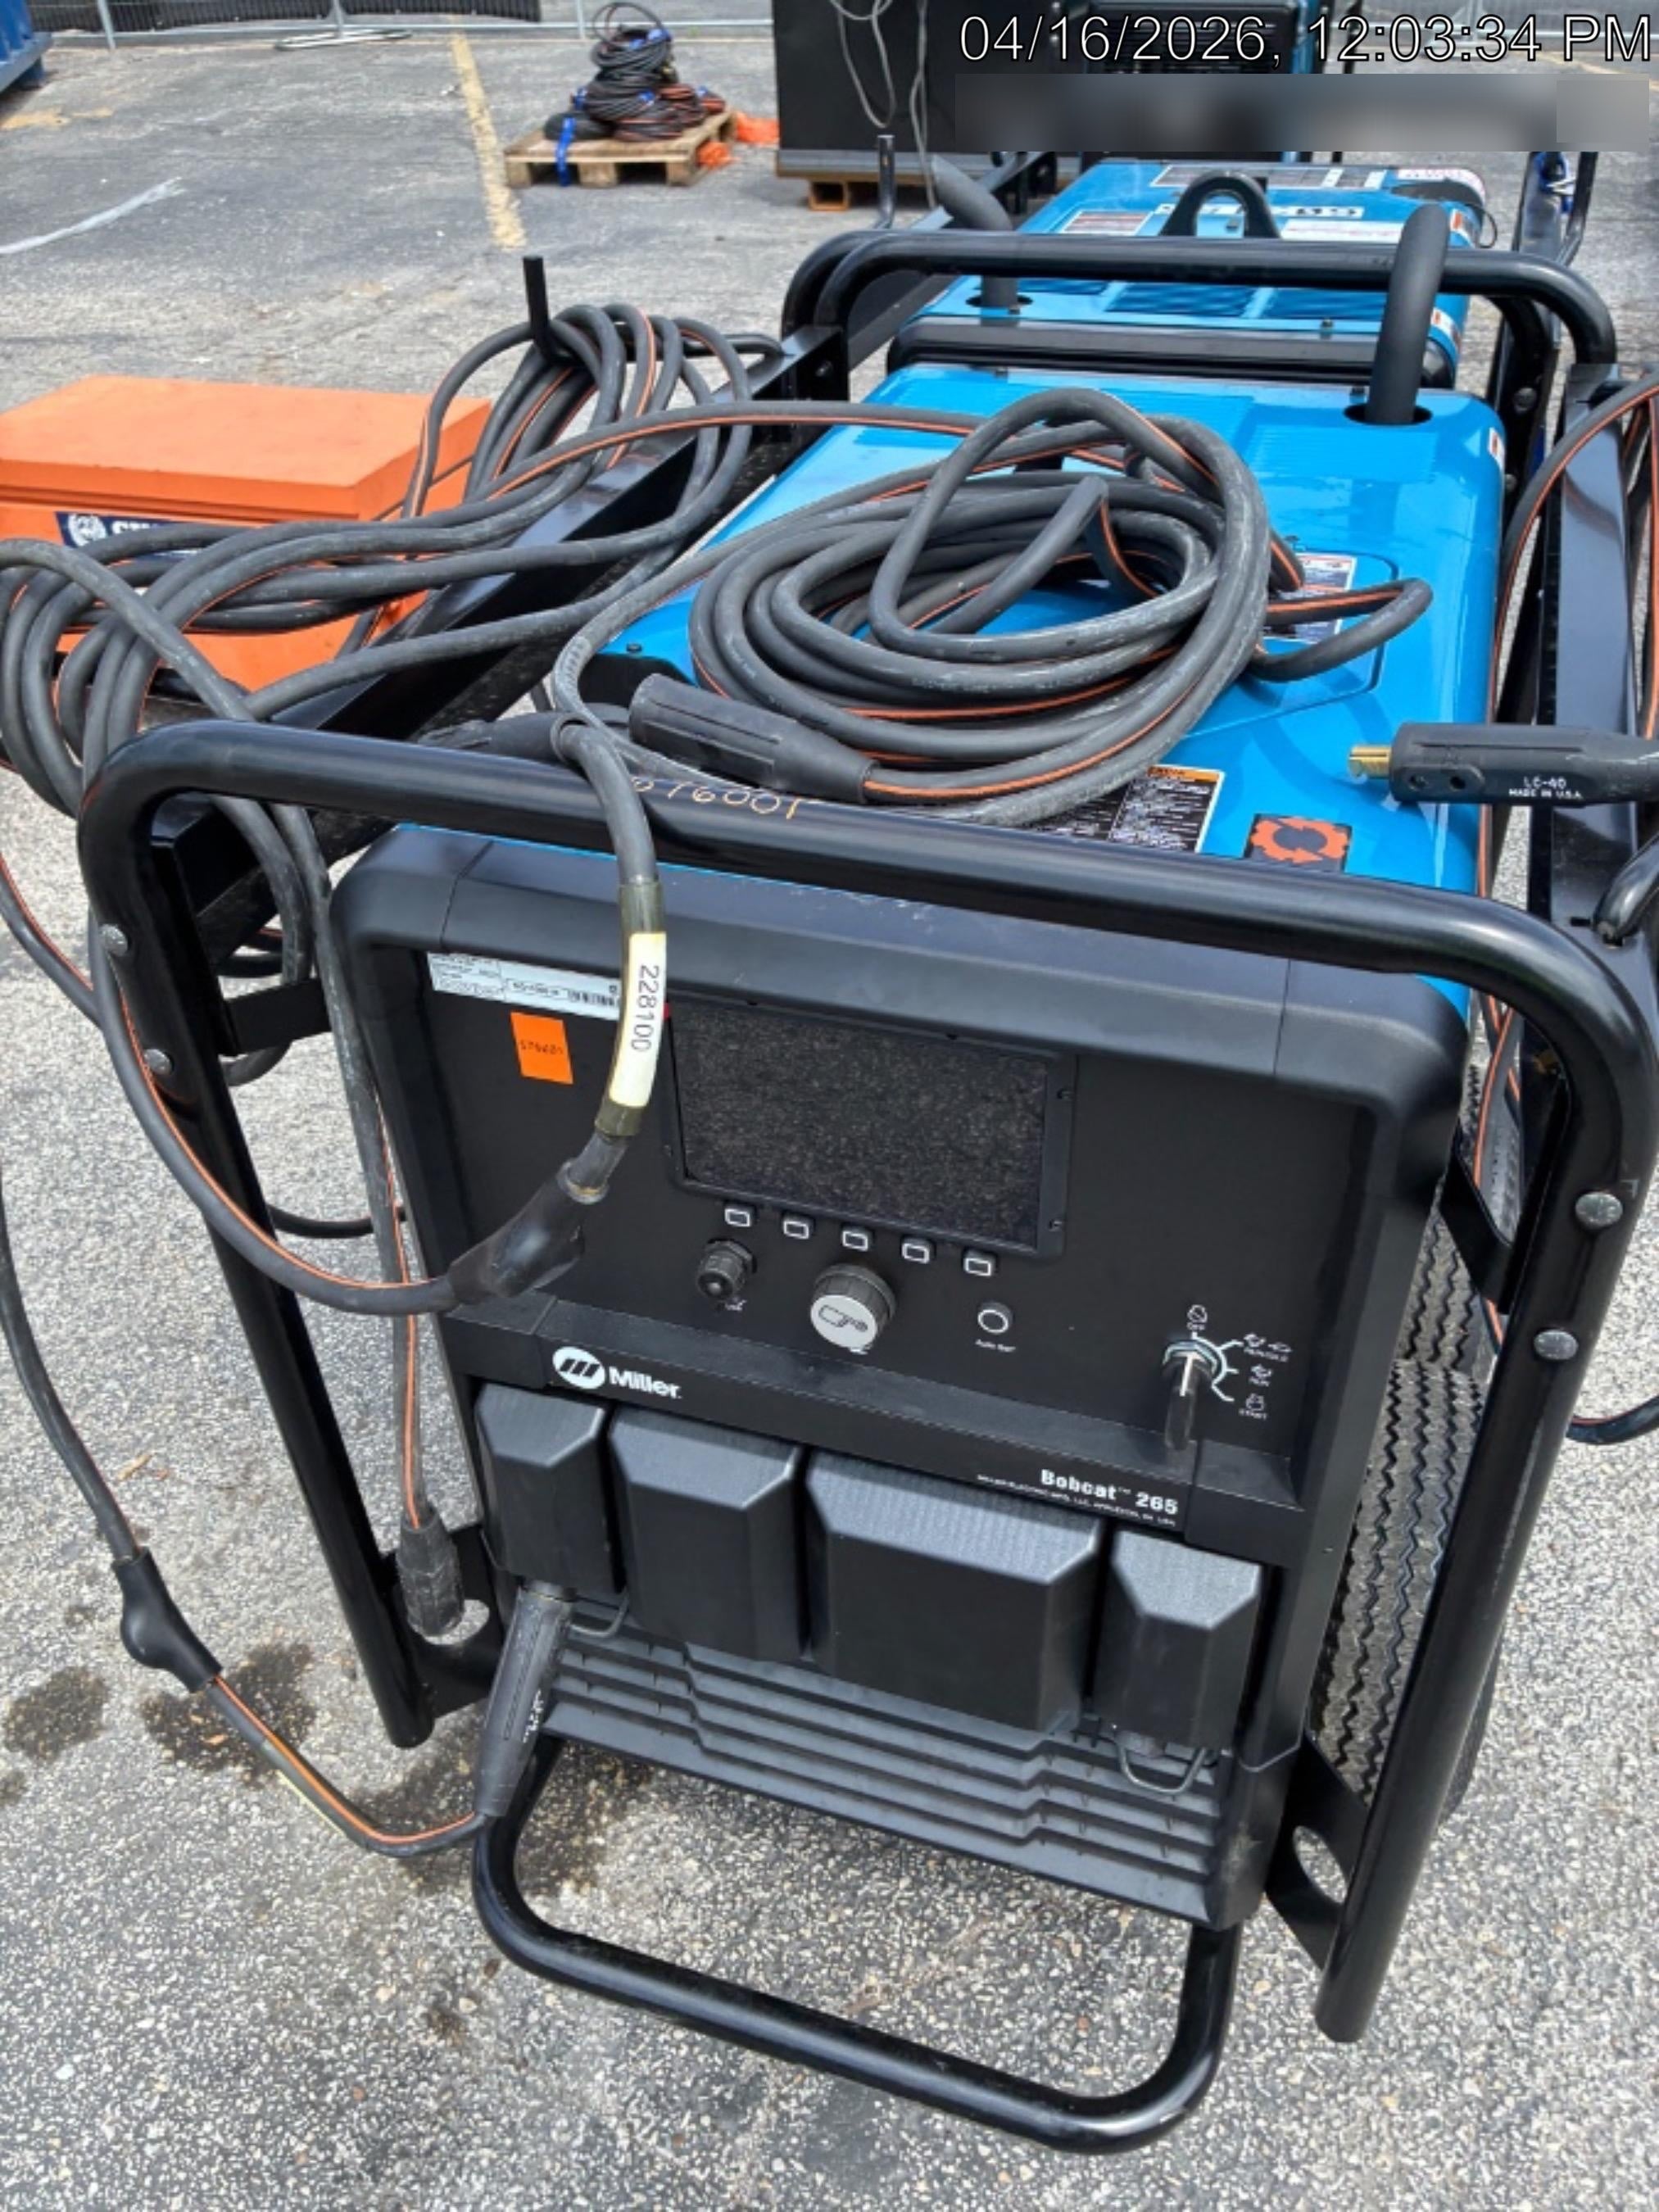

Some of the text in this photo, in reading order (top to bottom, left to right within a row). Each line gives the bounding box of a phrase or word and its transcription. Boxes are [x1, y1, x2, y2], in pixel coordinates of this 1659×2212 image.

[1508, 787, 1537, 798] MADE
[1540, 789, 1552, 798] IN
[1524, 776, 1566, 789] LC-40
[630, 964, 660, 1053] 228100
[608, 1366, 682, 1399] Miller
[1135, 1490, 1179, 1516] 265
